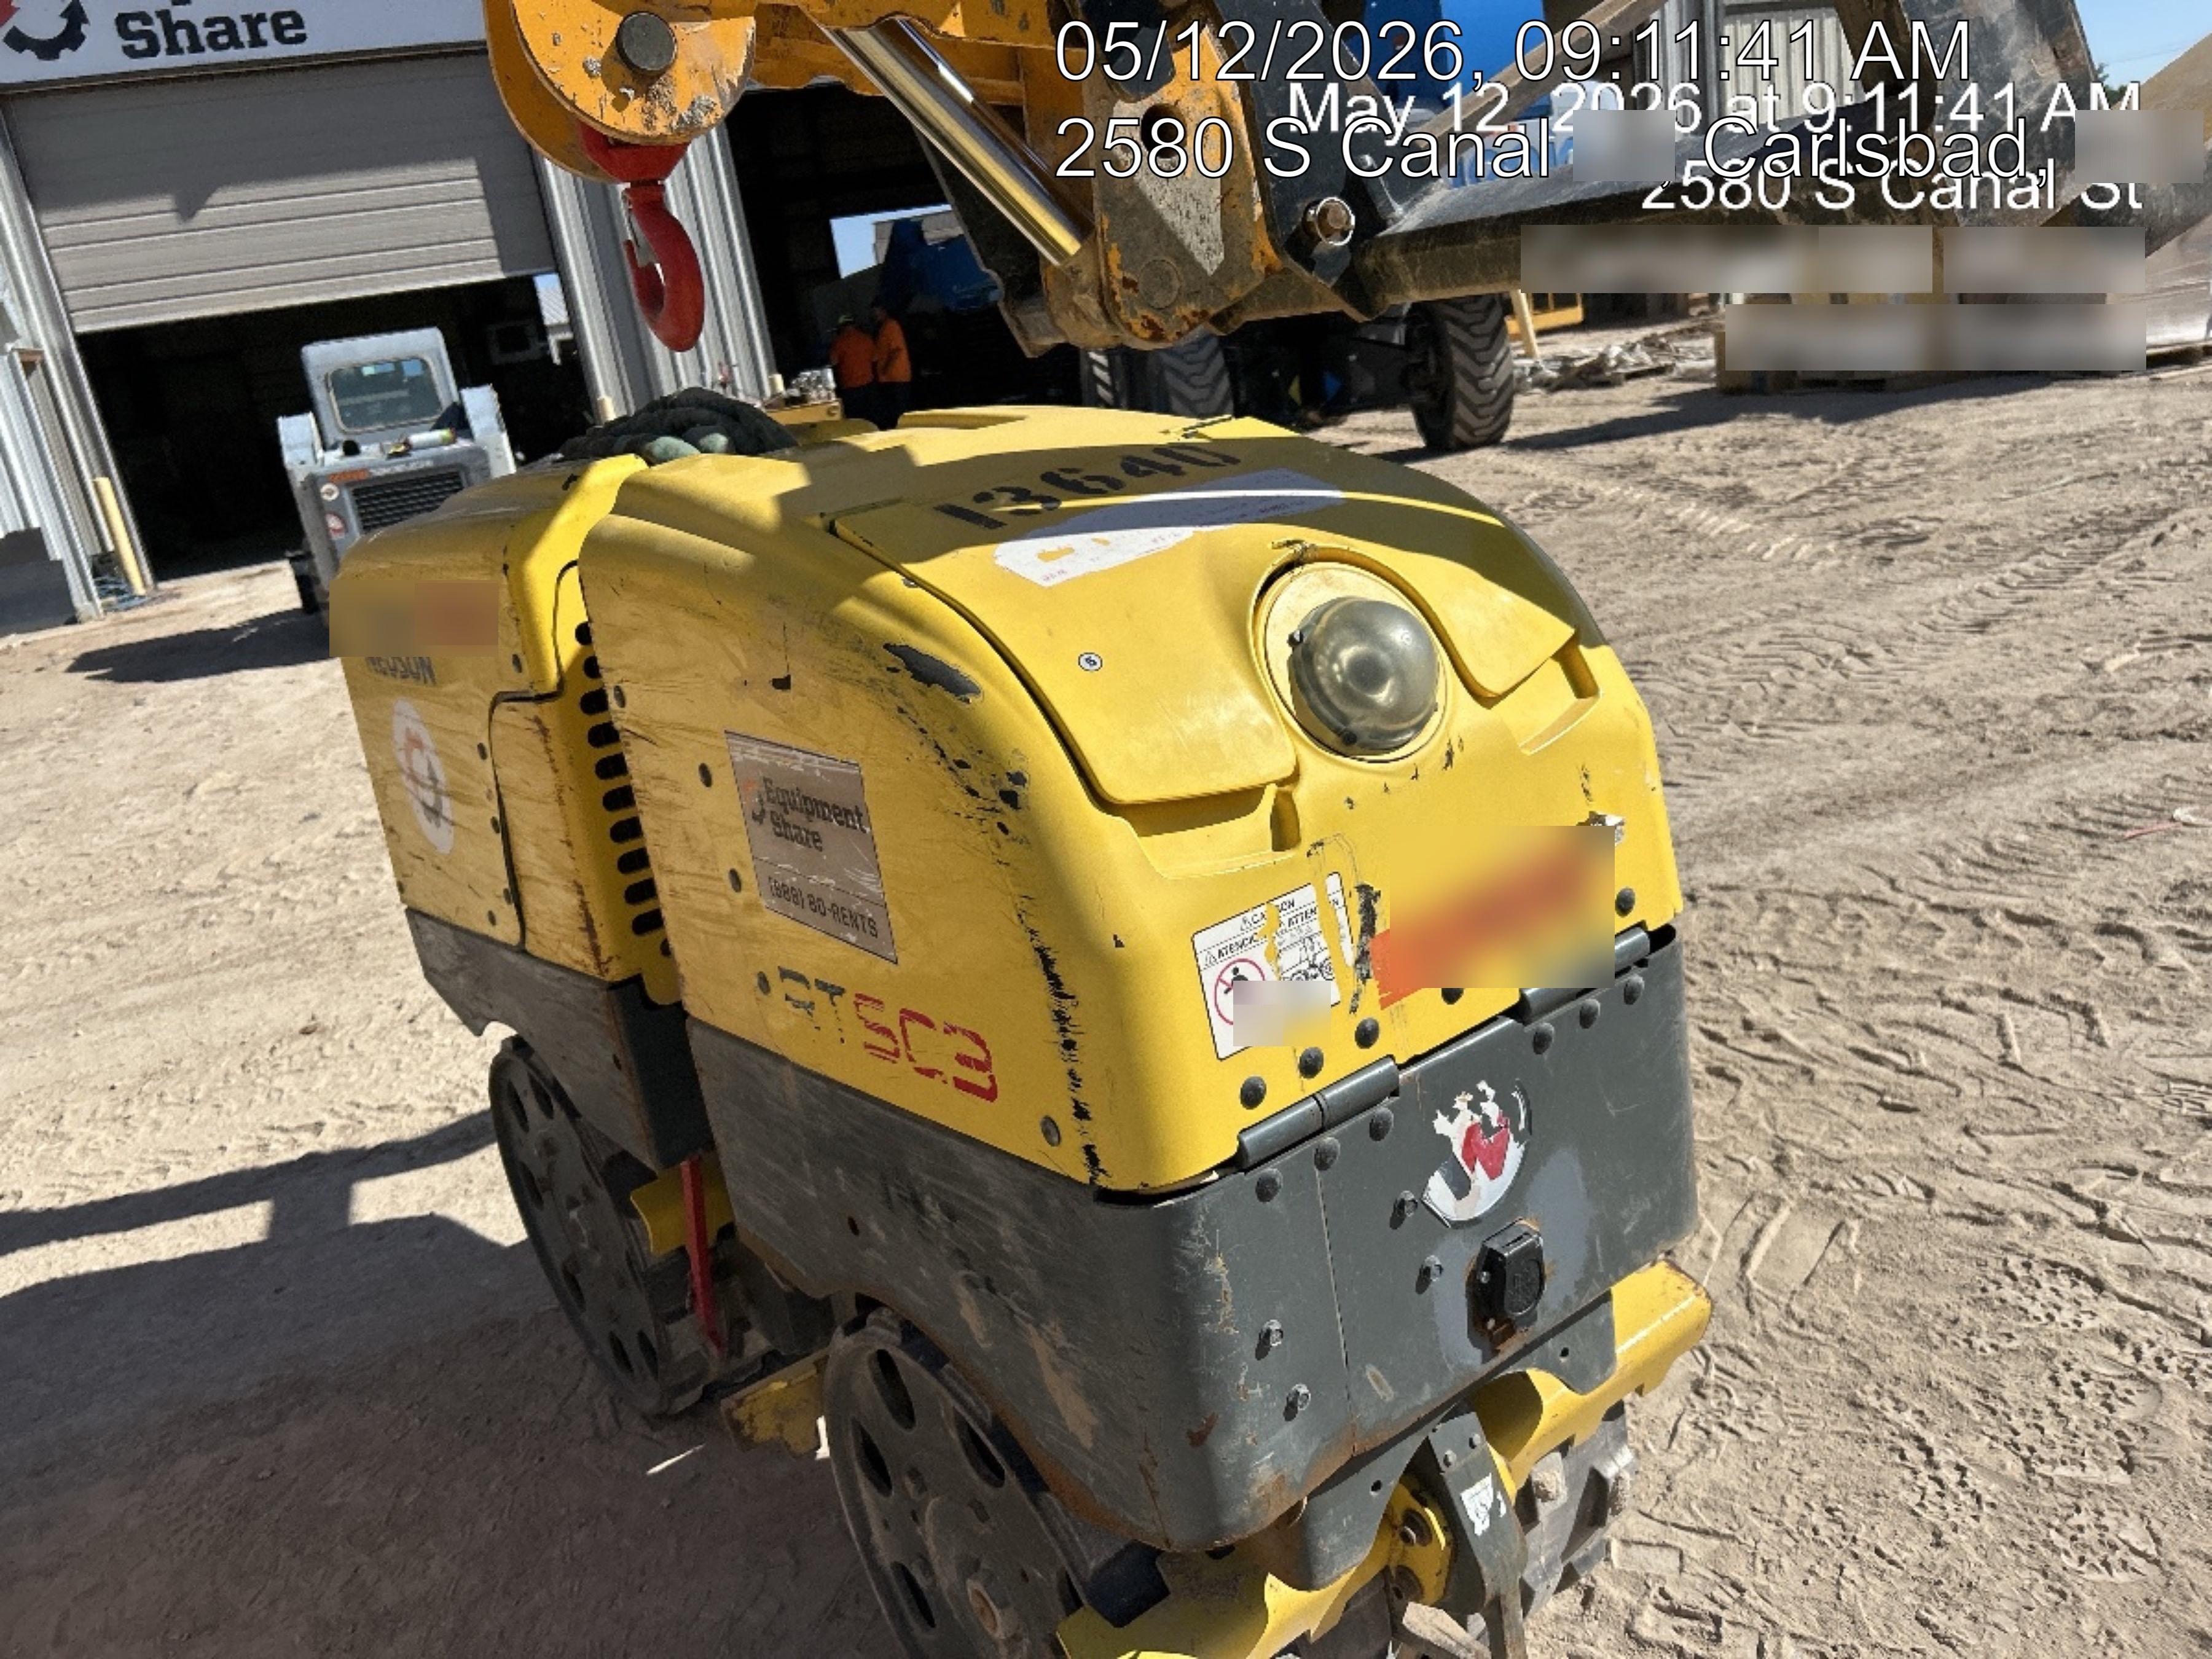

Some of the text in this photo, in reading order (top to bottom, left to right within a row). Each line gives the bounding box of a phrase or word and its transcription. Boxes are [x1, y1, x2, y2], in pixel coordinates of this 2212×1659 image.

[115, 9, 307, 59] Share
[934, 444, 1241, 530] 13640
[763, 777, 869, 834] Equipment
[769, 810, 823, 852] Share
[768, 876, 879, 939] (888) 80-RENTS
